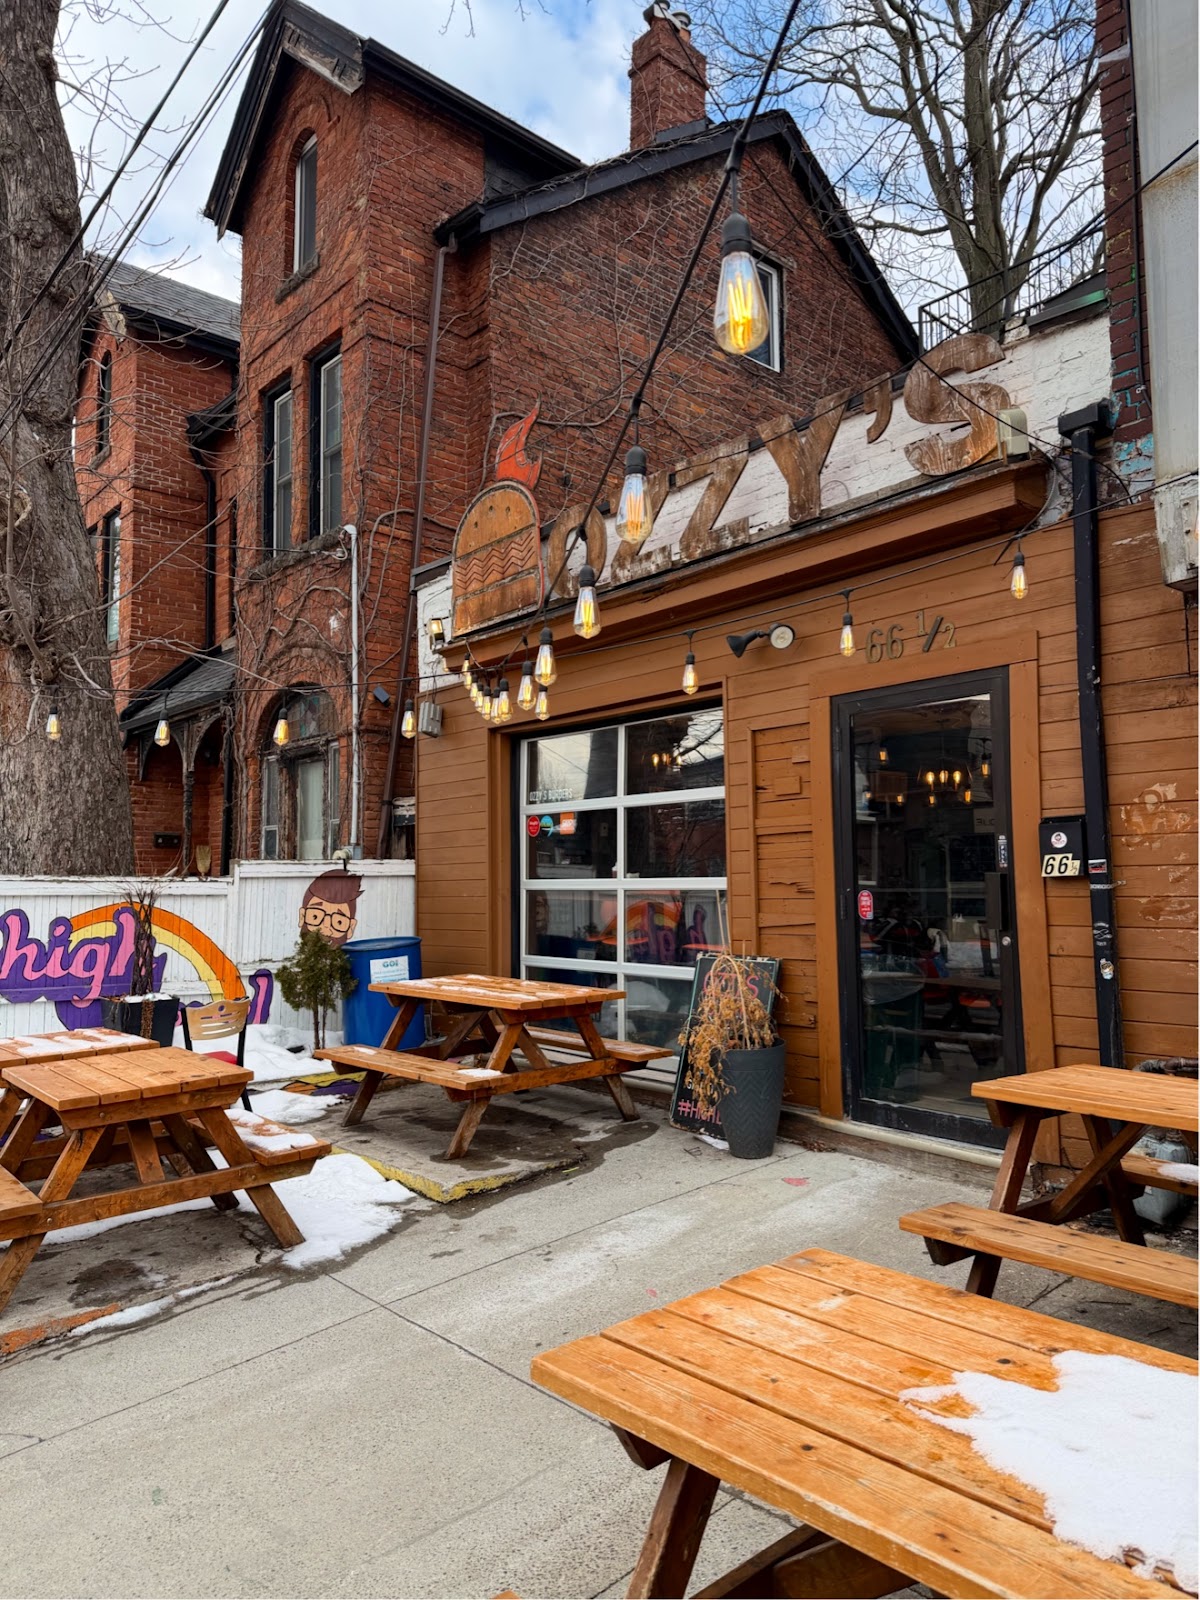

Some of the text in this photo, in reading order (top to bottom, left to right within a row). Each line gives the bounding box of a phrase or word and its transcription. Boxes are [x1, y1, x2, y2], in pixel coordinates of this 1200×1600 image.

[546, 333, 1011, 599] OZZY'S
[865, 623, 904, 664] 66
[1044, 855, 1069, 875] 66
